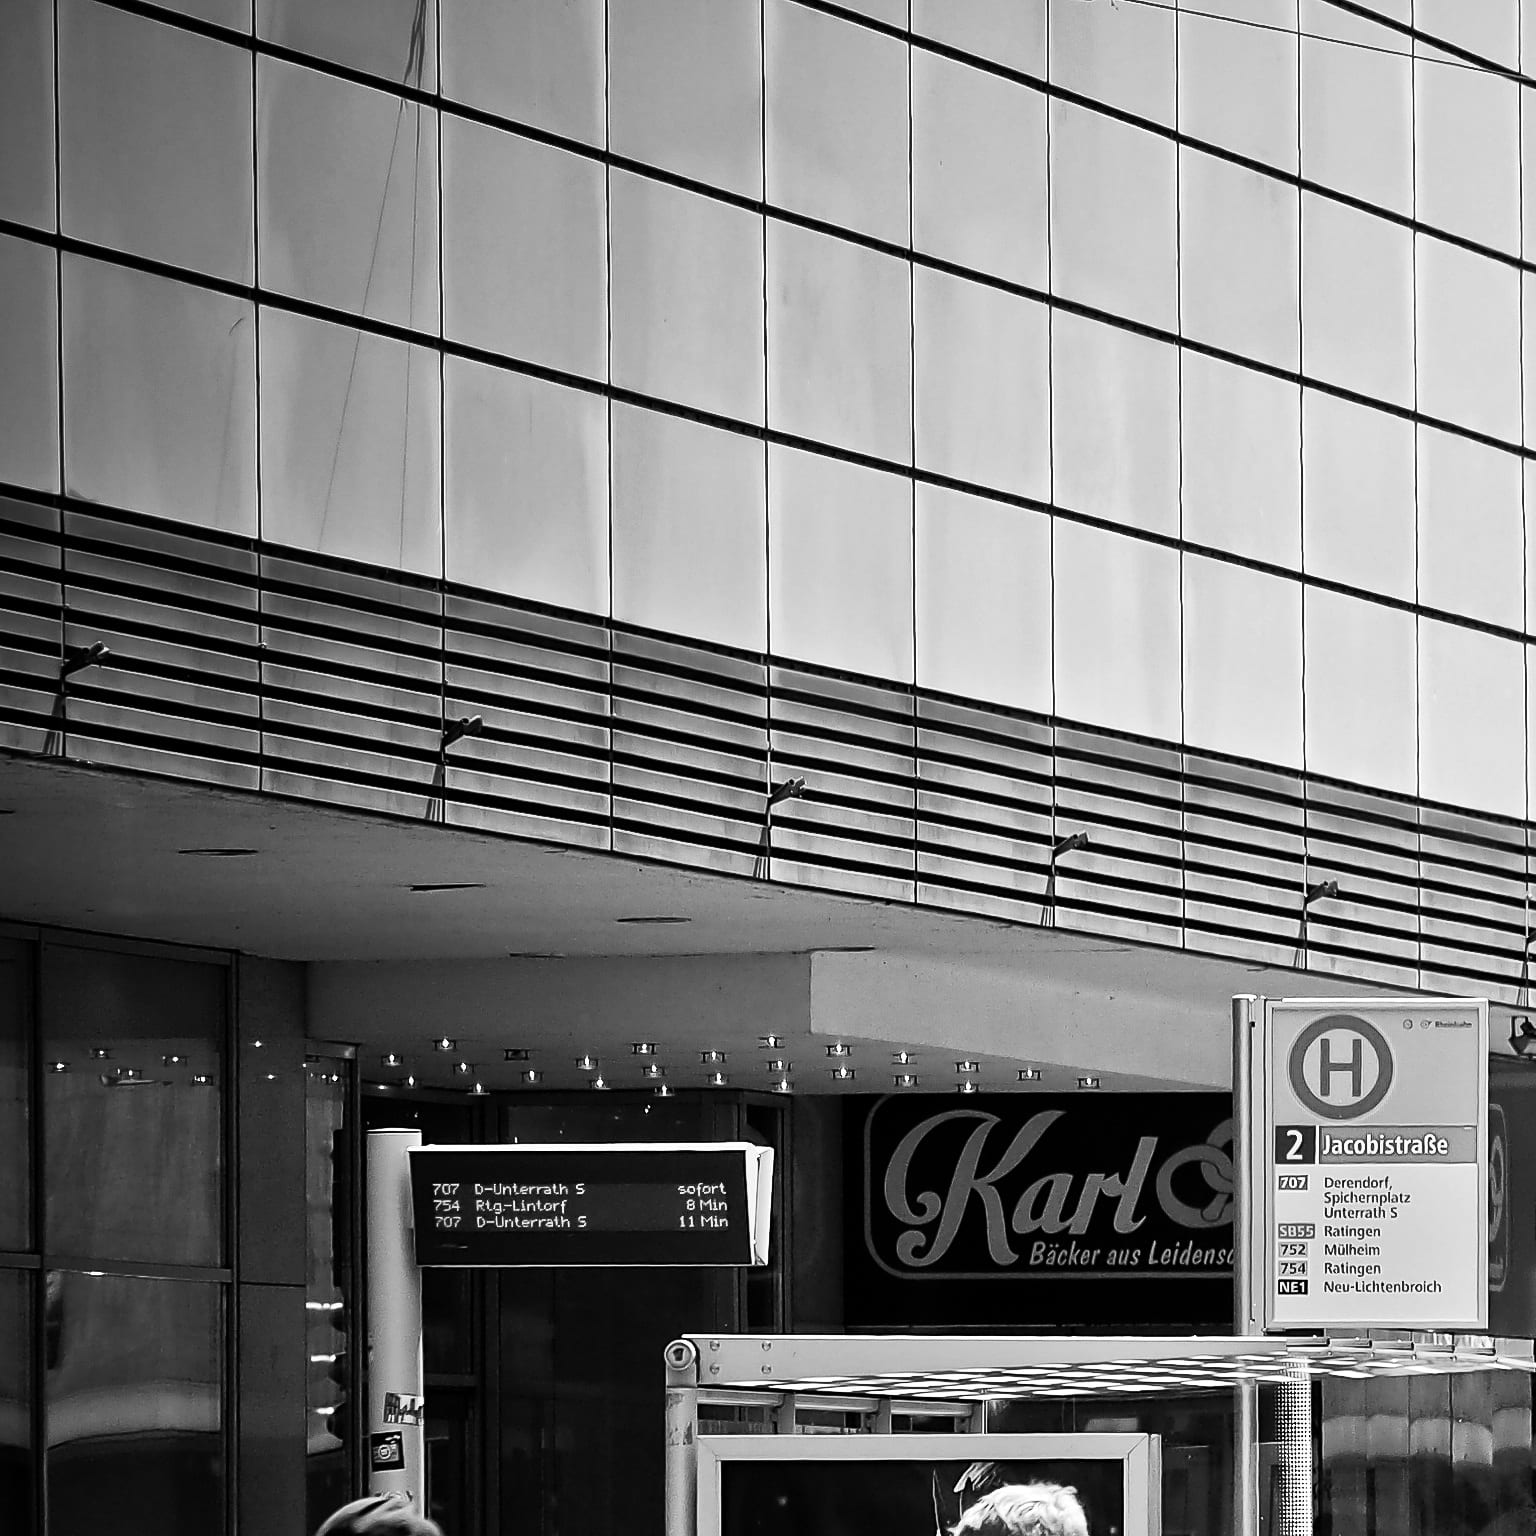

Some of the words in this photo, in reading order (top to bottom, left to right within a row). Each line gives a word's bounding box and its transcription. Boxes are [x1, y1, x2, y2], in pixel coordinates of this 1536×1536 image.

[1286, 1129, 1303, 1160] 2
[1322, 1133, 1449, 1157] Jacobistraße
[432, 1183, 460, 1196] 707
[474, 1183, 569, 1195] D-Unterrath
[576, 1183, 586, 1195] S
[677, 1182, 727, 1195] sofort
[884, 1109, 1158, 1266] Karl
[1280, 1176, 1307, 1189] 707
[1324, 1176, 1393, 1191] Derendorf,
[433, 1199, 461, 1212] 754
[686, 1199, 696, 1211] 8
[700, 1199, 728, 1211] Min
[1324, 1191, 1411, 1206] Spichernplatz
[1324, 1206, 1387, 1219] Unterrath
[1390, 1207, 1398, 1219] S
[434, 1216, 462, 1228] 707
[476, 1216, 571, 1228] D-Unterrath
[577, 1216, 587, 1228] S
[679, 1216, 696, 1228] 11
[700, 1215, 729, 1228] Min
[1280, 1225, 1315, 1238] SB55
[1324, 1225, 1381, 1241] Ratingen
[1029, 1241, 1100, 1265] Bäcker
[1106, 1248, 1141, 1265] aus
[1280, 1244, 1307, 1256] 752
[1324, 1243, 1381, 1256] Mülheim
[1280, 1263, 1307, 1275] 754
[1324, 1262, 1381, 1277] Ratingen
[1280, 1281, 1307, 1293] NE1
[1324, 1280, 1442, 1293] Neu-Lichtenbroich
